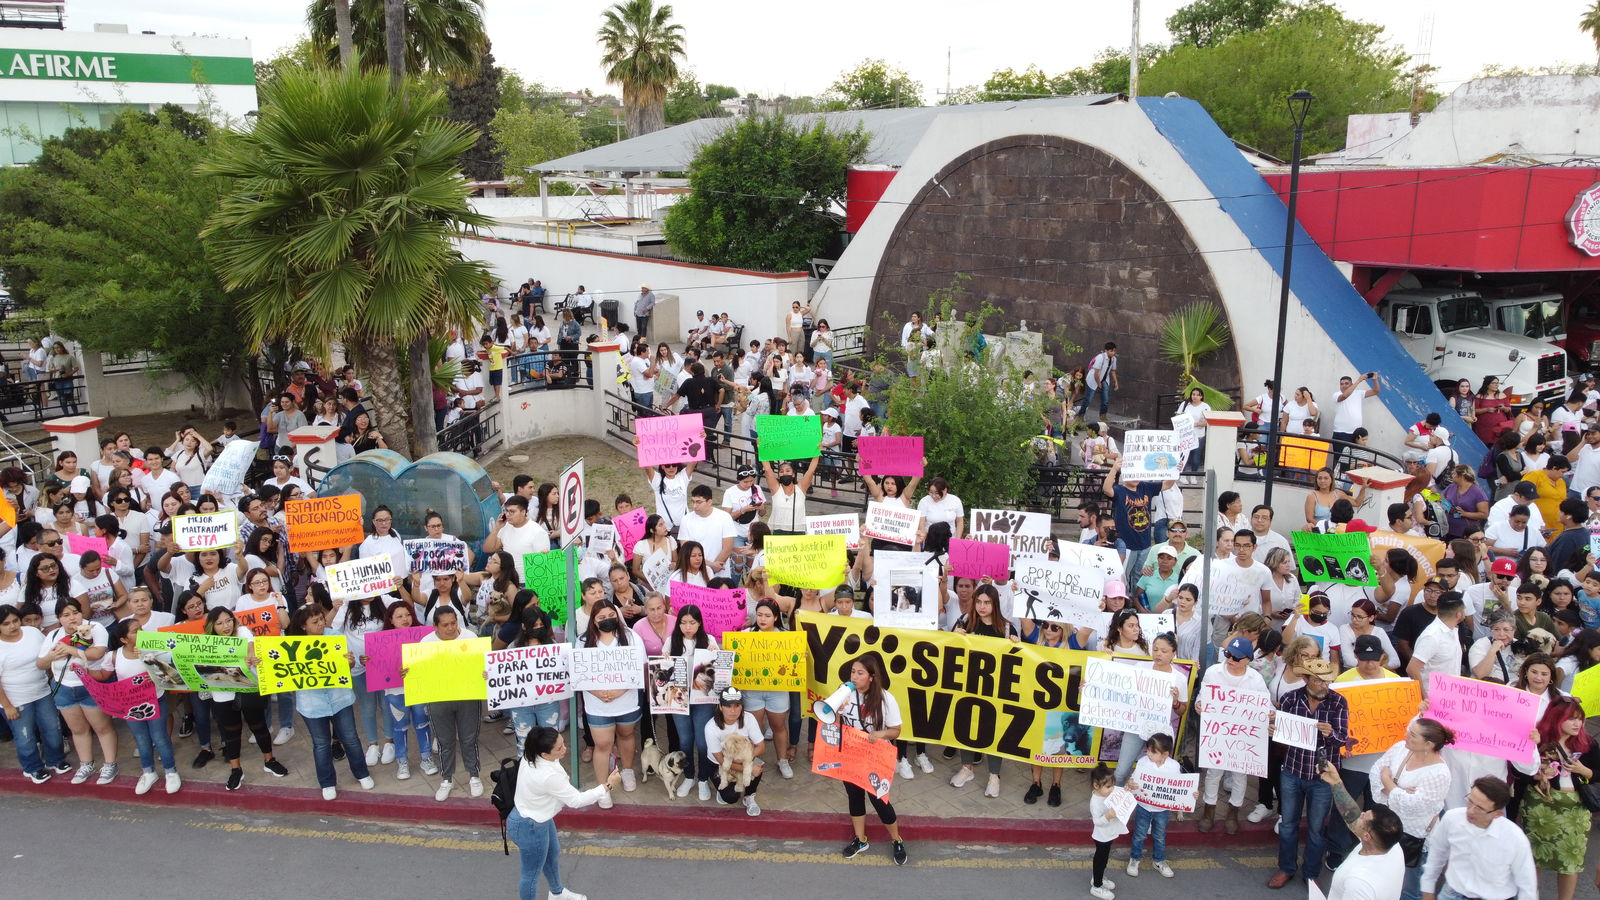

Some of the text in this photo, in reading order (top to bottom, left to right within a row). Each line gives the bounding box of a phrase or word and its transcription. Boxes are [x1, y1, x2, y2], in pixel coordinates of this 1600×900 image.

[9, 53, 117, 79] AFIRME
[1135, 435, 1145, 444] QUE
[1148, 435, 1154, 444] NO
[1156, 435, 1172, 444] SABE
[286, 498, 342, 514] ESTAMOS
[188, 516, 212, 524] MEJOR
[286, 508, 359, 526] INDIGNADOS
[884, 518, 910, 529] MALTRATO
[182, 522, 228, 533] MALTRATAME
[880, 524, 900, 534] ANIMAL
[188, 534, 218, 546] ESTA
[405, 542, 431, 550] MUCHOS
[1372, 534, 1404, 548] patita
[424, 550, 446, 558] POCA
[766, 541, 798, 554] Hagamos
[962, 542, 984, 563] YA
[410, 560, 464, 572] HUMANIDAD
[525, 554, 544, 566] NO
[767, 556, 776, 565] Yo
[1406, 544, 1436, 577] menos!
[336, 562, 392, 582] EL HUMANO
[526, 564, 553, 578] CON
[1029, 566, 1080, 586] POR LOS
[346, 579, 394, 594] MAS CRUEL
[360, 576, 382, 584] ANIMAL
[526, 577, 549, 588] VOZ
[1022, 575, 1100, 600] QUE NO TIENEN
[141, 640, 165, 650] ANTES
[176, 634, 242, 646] SALVA Y HAZ TU
[190, 644, 218, 654] PARTE
[573, 649, 638, 662] EL HOMBRE
[750, 652, 780, 663] TIENEN
[273, 660, 337, 678] SERE SU
[498, 658, 556, 674] PARA LOS
[574, 661, 641, 674] ES EL ANIMAL
[910, 641, 1024, 702] SERÉ
[292, 676, 335, 690] VOZ
[488, 670, 570, 688] QUE NO TIENEN
[498, 683, 566, 700] UNA VOZ
[1084, 684, 1166, 712] con animales NO se
[1206, 684, 1226, 702] TU
[1436, 674, 1448, 692] Yo
[1450, 682, 1488, 698] marcho
[1516, 692, 1532, 708] los
[1081, 702, 1120, 718] detiene
[1370, 706, 1394, 720] LOS
[1440, 698, 1513, 720] que NO tienen
[907, 687, 1035, 758] VOZ
[1204, 720, 1262, 740] YO SERE
[1200, 736, 1260, 757] TU VOZ
[1034, 754, 1075, 765] MONCLOVA,
[1140, 772, 1194, 788] ¡ESTOY HARTO!
[1142, 783, 1188, 796] DEL MALTRATO
[1152, 792, 1176, 802] ANIMAL
